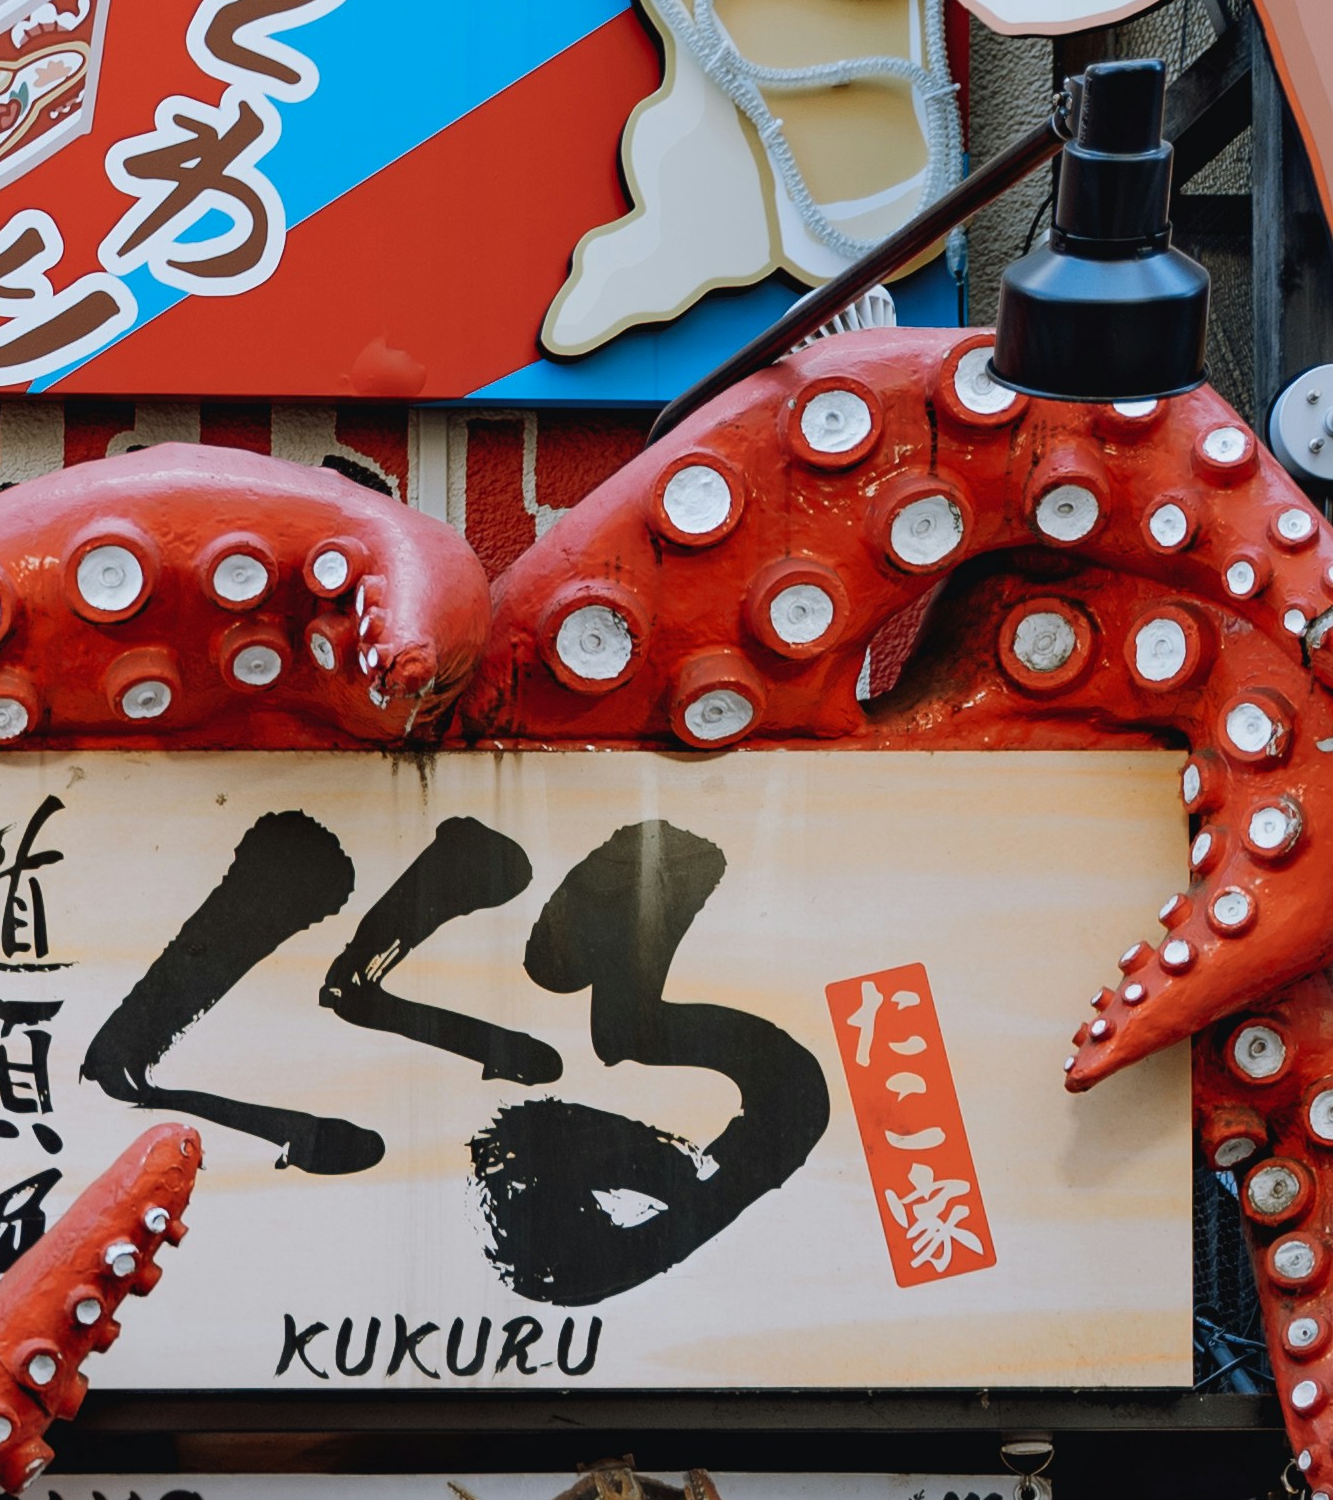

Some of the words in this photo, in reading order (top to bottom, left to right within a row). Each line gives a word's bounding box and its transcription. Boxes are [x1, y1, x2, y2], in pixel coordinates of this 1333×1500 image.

[79, 808, 831, 1307] くくる
[846, 979, 984, 1273] たこ家
[273, 1313, 604, 1381] KUKURU
